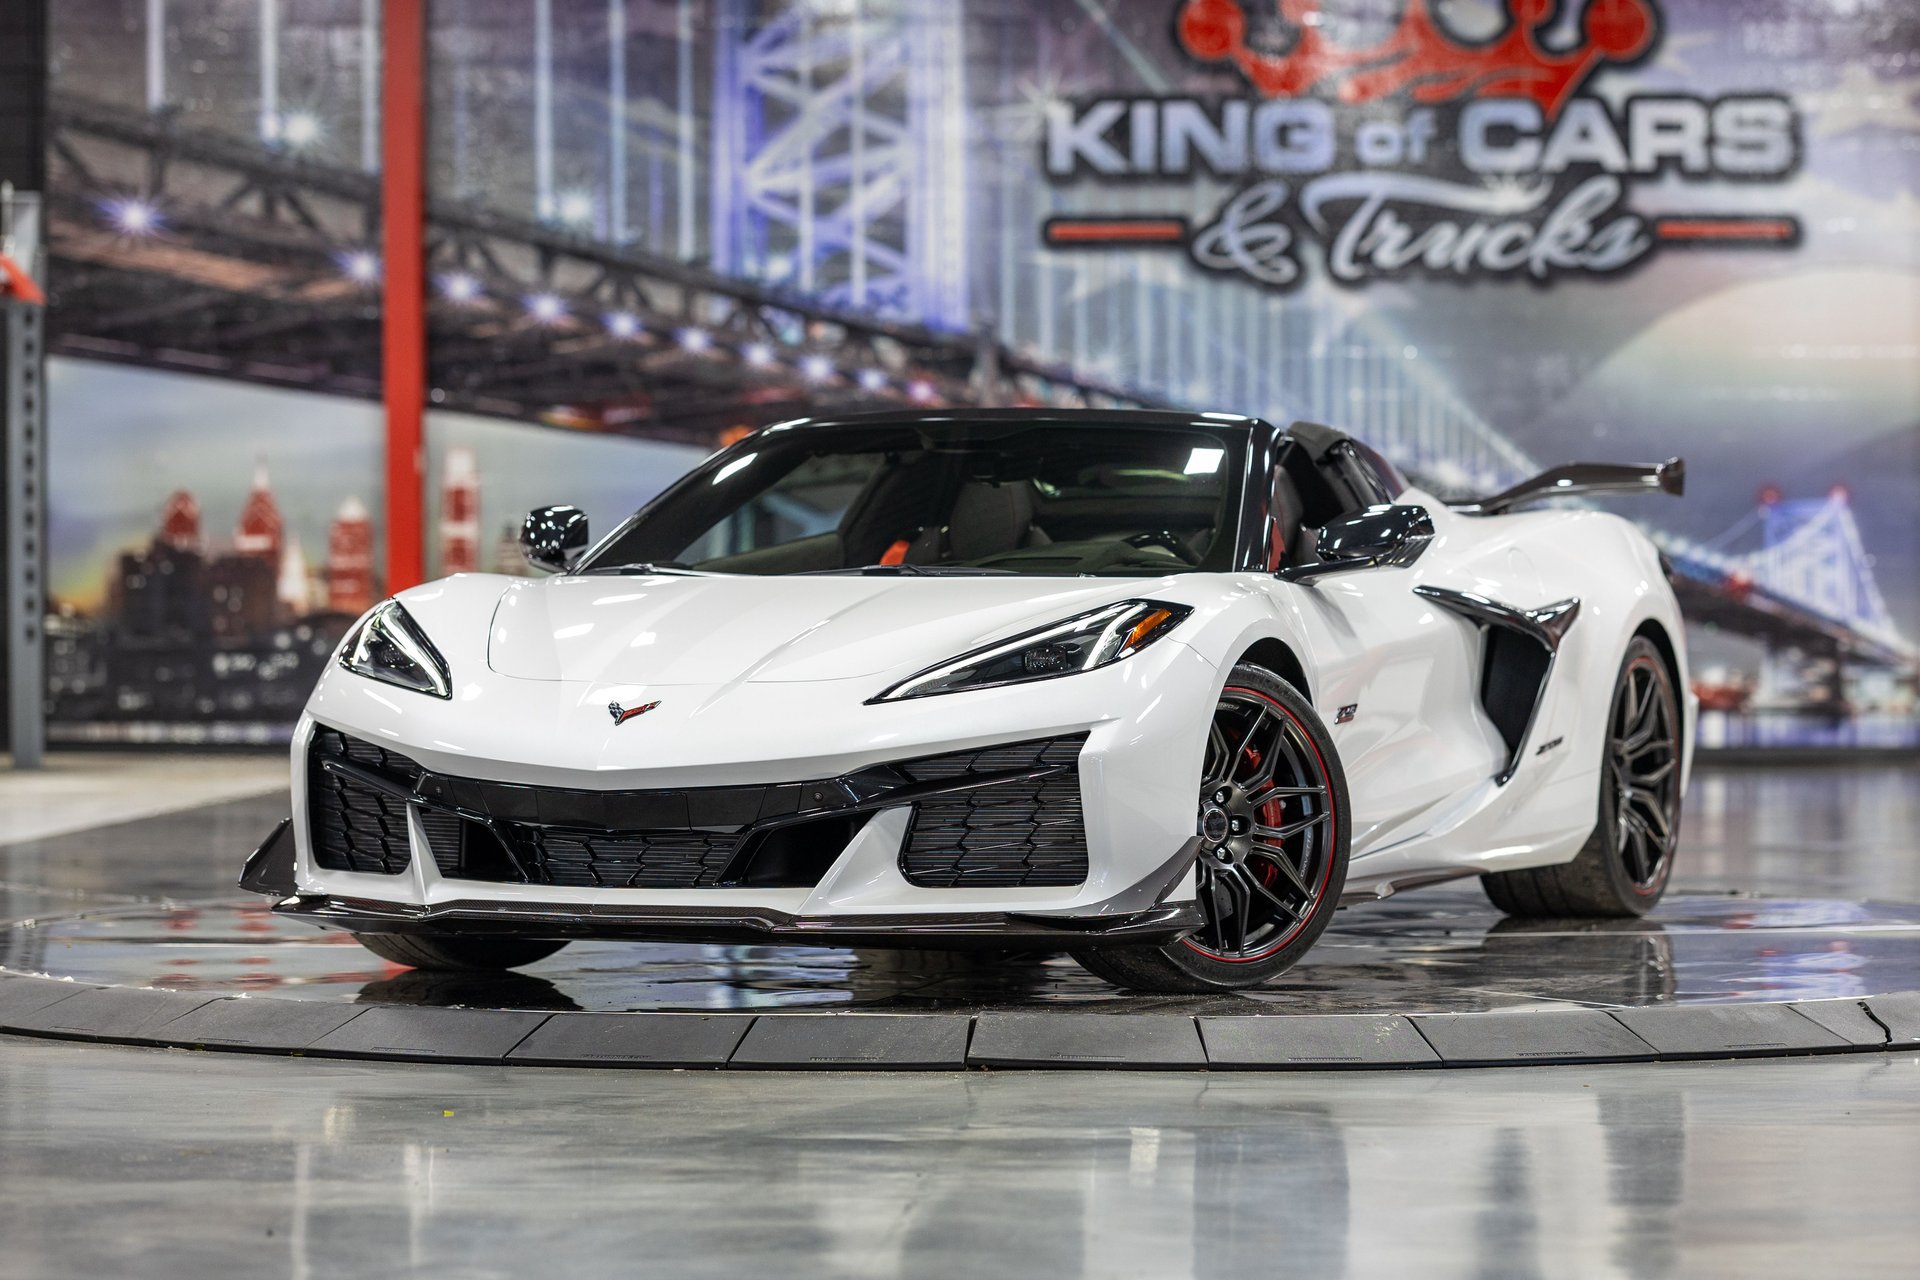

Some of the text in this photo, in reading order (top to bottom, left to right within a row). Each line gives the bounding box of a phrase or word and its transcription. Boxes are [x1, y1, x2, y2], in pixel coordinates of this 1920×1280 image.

[1048, 98, 1797, 175] KING of CARS
[1193, 171, 1648, 284] & Trucks
